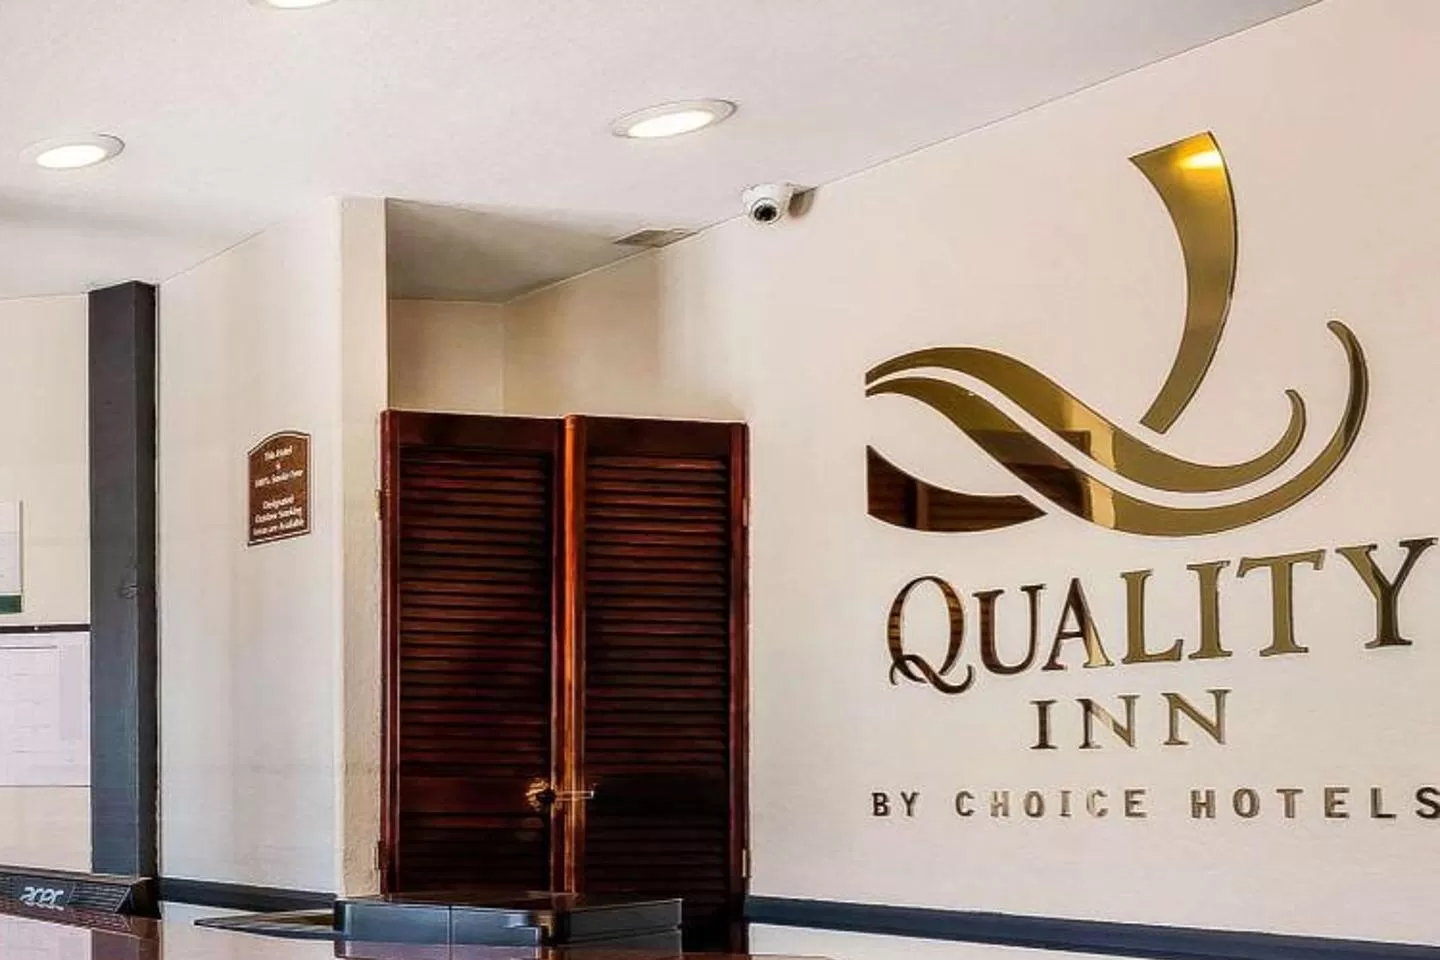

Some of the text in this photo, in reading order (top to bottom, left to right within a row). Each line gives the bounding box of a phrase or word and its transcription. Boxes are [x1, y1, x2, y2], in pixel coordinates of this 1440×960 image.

[886, 537, 1439, 695] QUALITY
[1029, 688, 1233, 751] INN
[871, 787, 1440, 820] BY CHOICE HOTELS
[20, 886, 65, 905] acer
